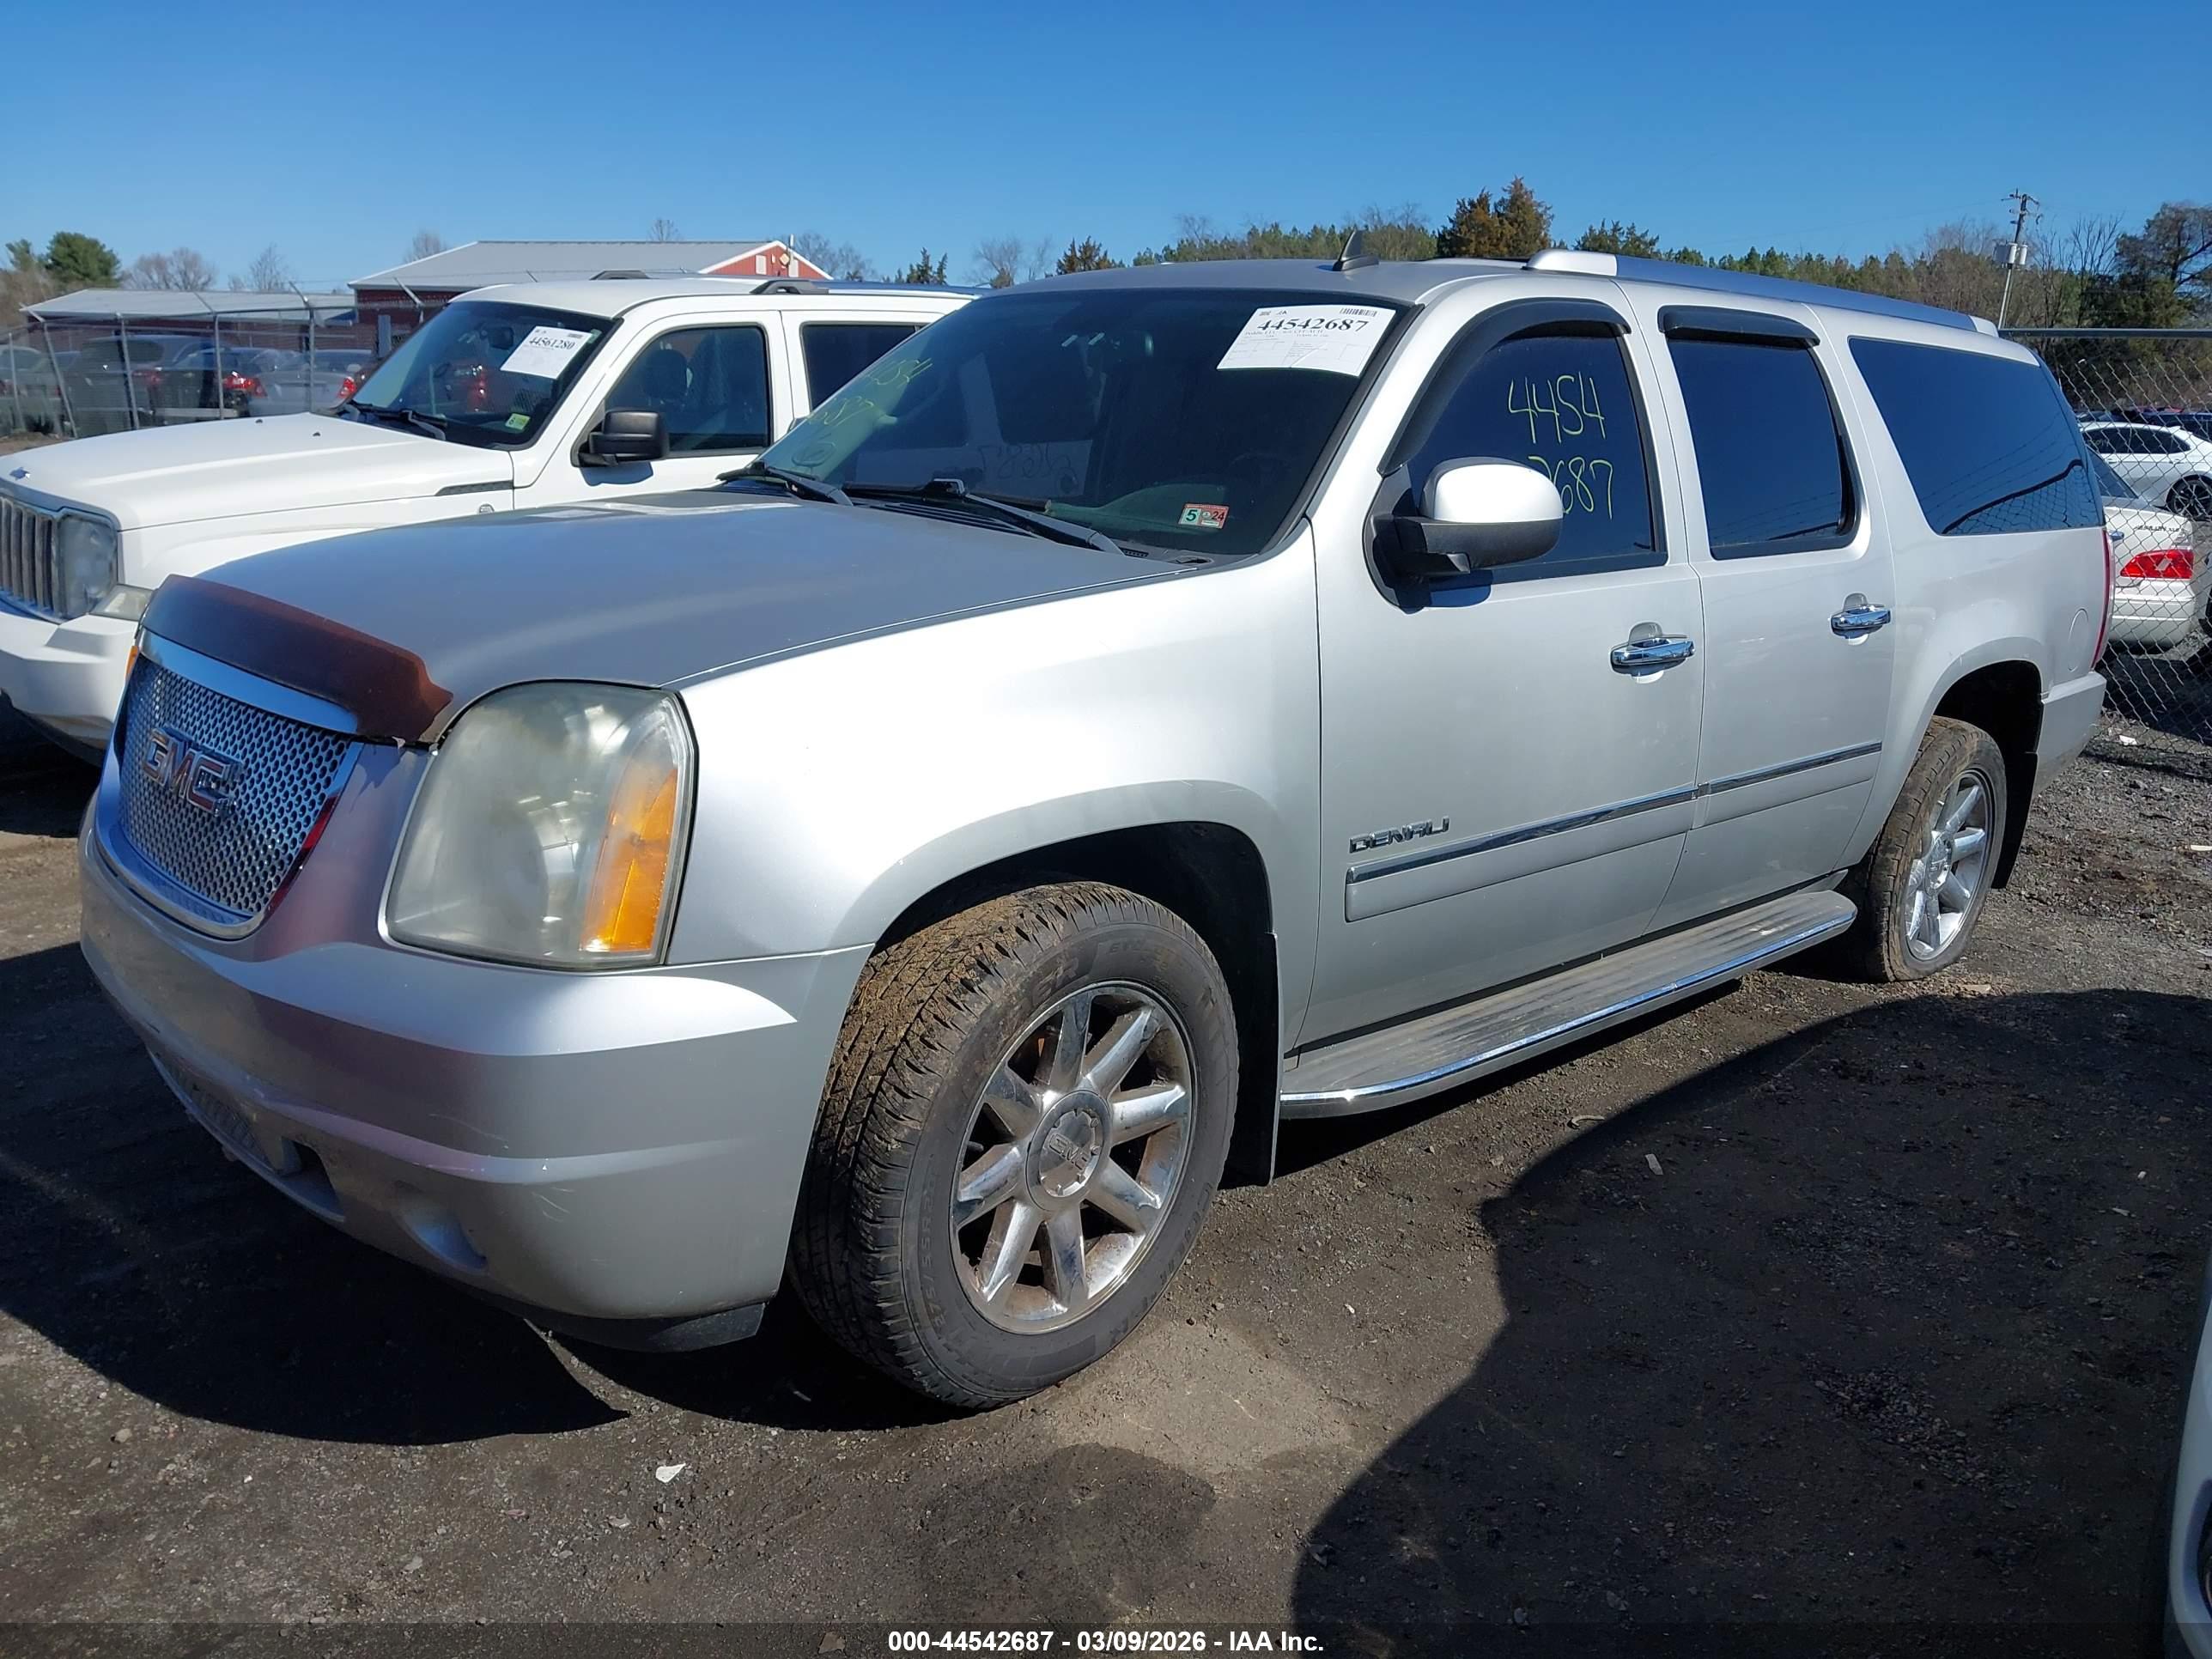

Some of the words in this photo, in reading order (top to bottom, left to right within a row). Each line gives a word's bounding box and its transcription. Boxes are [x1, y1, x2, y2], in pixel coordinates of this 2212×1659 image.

[529, 337, 575, 349] 44561280
[1257, 318, 1370, 332] 44542687
[1508, 370, 1607, 444] 4454
[1186, 509, 1198, 521] 5
[1212, 511, 1224, 521] 24
[142, 729, 230, 812] GMC
[1348, 816, 1449, 854] DENALI
[1048, 1133, 1090, 1171] GMC
